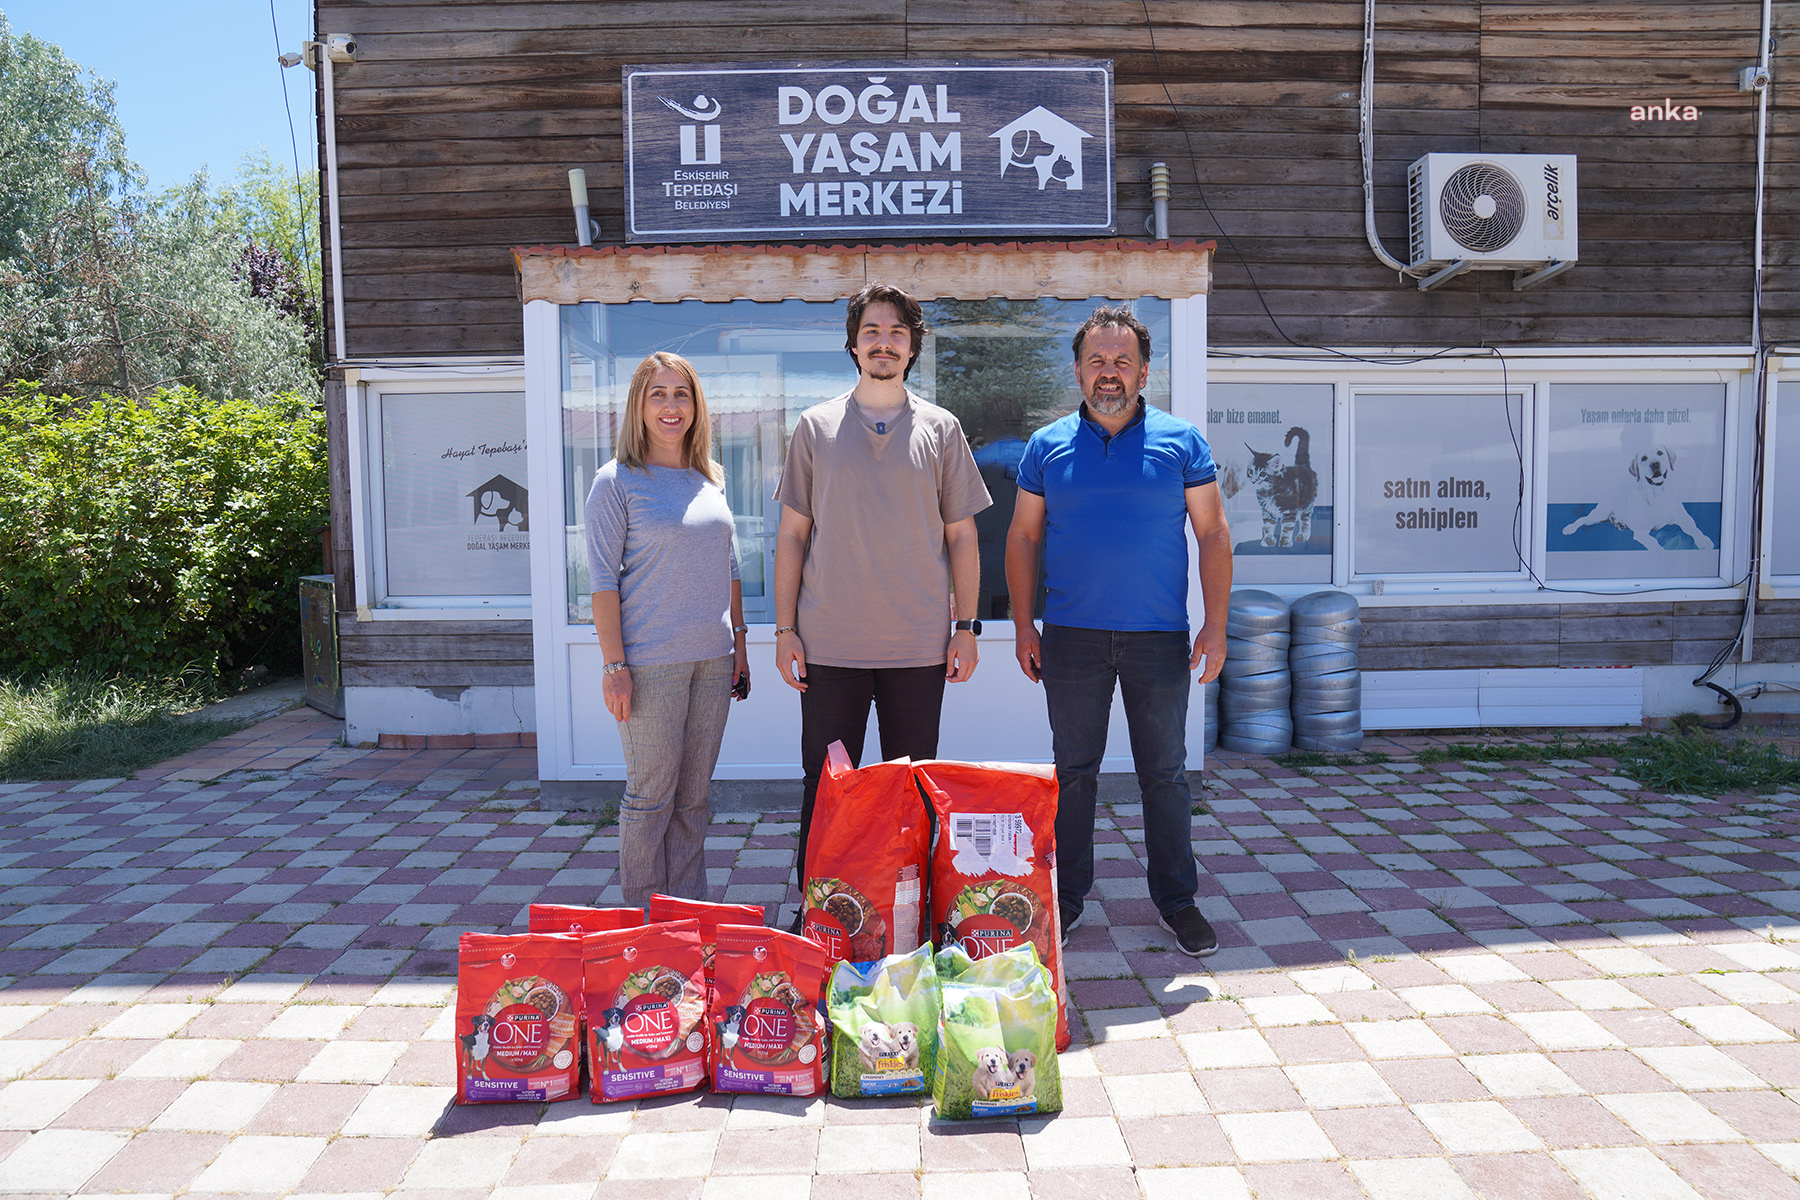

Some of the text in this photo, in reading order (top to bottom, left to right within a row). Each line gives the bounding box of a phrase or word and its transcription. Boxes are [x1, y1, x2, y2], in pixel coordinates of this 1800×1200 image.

[778, 76, 961, 125] DOĞAL
[779, 131, 962, 176] YAŞAM
[1544, 163, 1562, 221] arçelik
[1226, 408, 1245, 424] bize
[1247, 409, 1282, 424] emanet.
[1580, 408, 1692, 426] Yaşam onlarla daha güzel.
[441, 445, 476, 461] Hayat
[1383, 476, 1491, 501] satın alma,
[1395, 507, 1478, 532] sahiplen
[466, 541, 487, 550] DOĞAL
[488, 542, 509, 552] YAŞAM
[815, 924, 840, 936] PURINA
[642, 1002, 668, 1010] PURINA
[624, 1010, 673, 1033] ONE
[744, 1014, 787, 1037] ONE
[493, 1022, 542, 1044] ONE
[877, 1060, 904, 1069] Friskies
[611, 1070, 655, 1082] SENSITIVE
[723, 1069, 765, 1081] SENSITIVE
[474, 1080, 519, 1089] SENSITIVE
[992, 1089, 1019, 1098] Friskies
